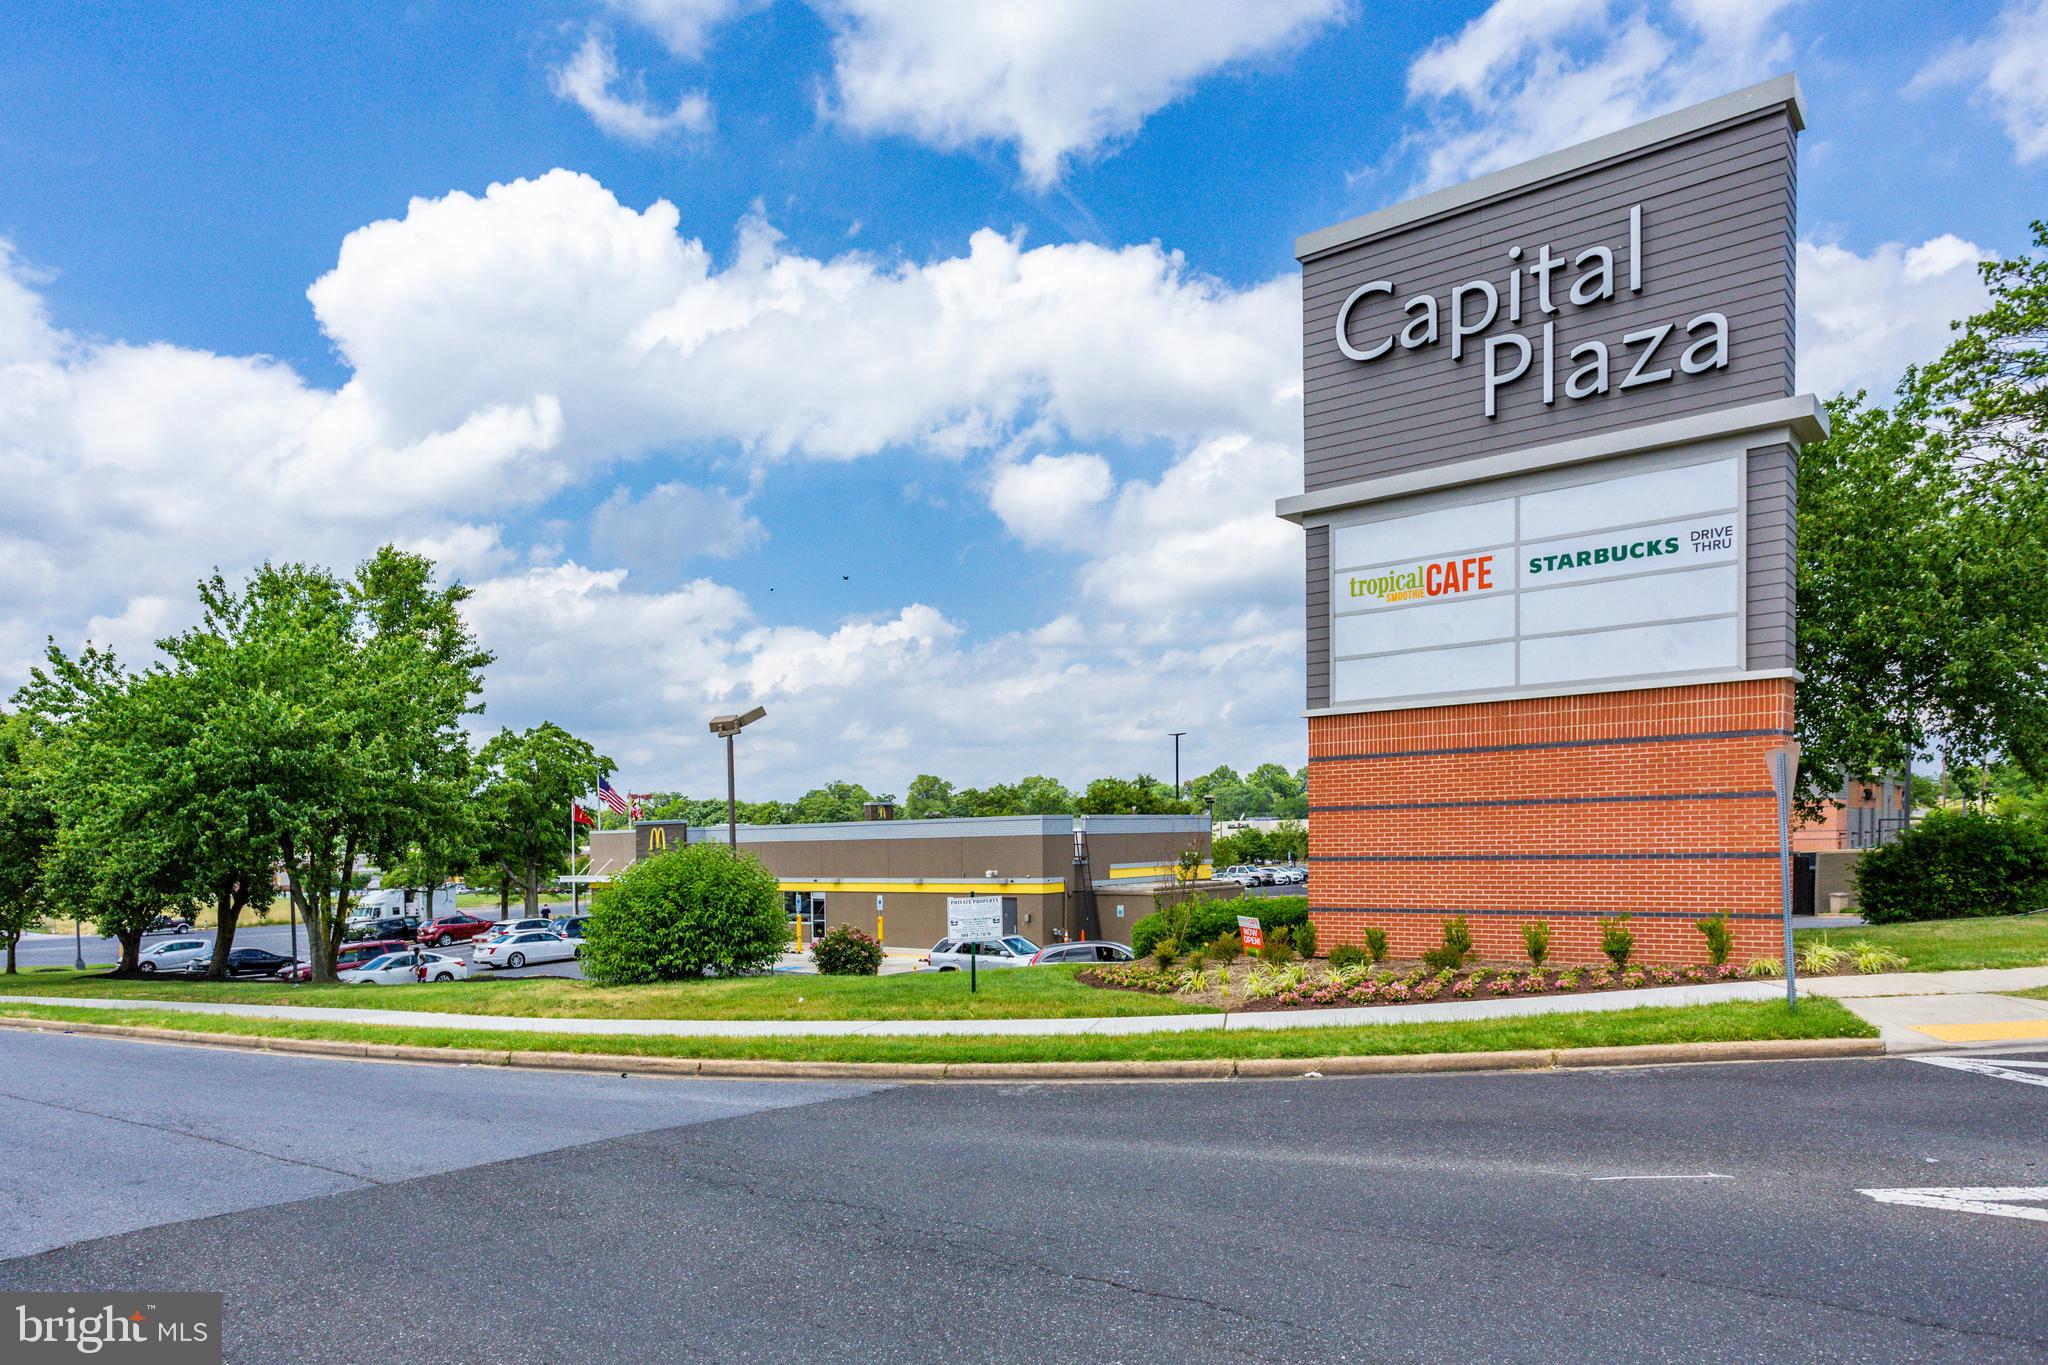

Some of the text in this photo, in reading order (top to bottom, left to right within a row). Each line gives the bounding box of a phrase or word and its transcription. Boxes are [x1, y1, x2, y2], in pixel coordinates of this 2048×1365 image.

[1335, 203, 1644, 362] Capital
[1484, 311, 1730, 419] Plaza
[1690, 525, 1734, 542] DRIVE
[1693, 538, 1732, 553] THRU
[1529, 537, 1680, 574] STARBUCKS
[1349, 555, 1493, 598] tropical CAFE
[1386, 588, 1425, 603] SMOOTHIE
[1243, 927, 1258, 937] NOW
